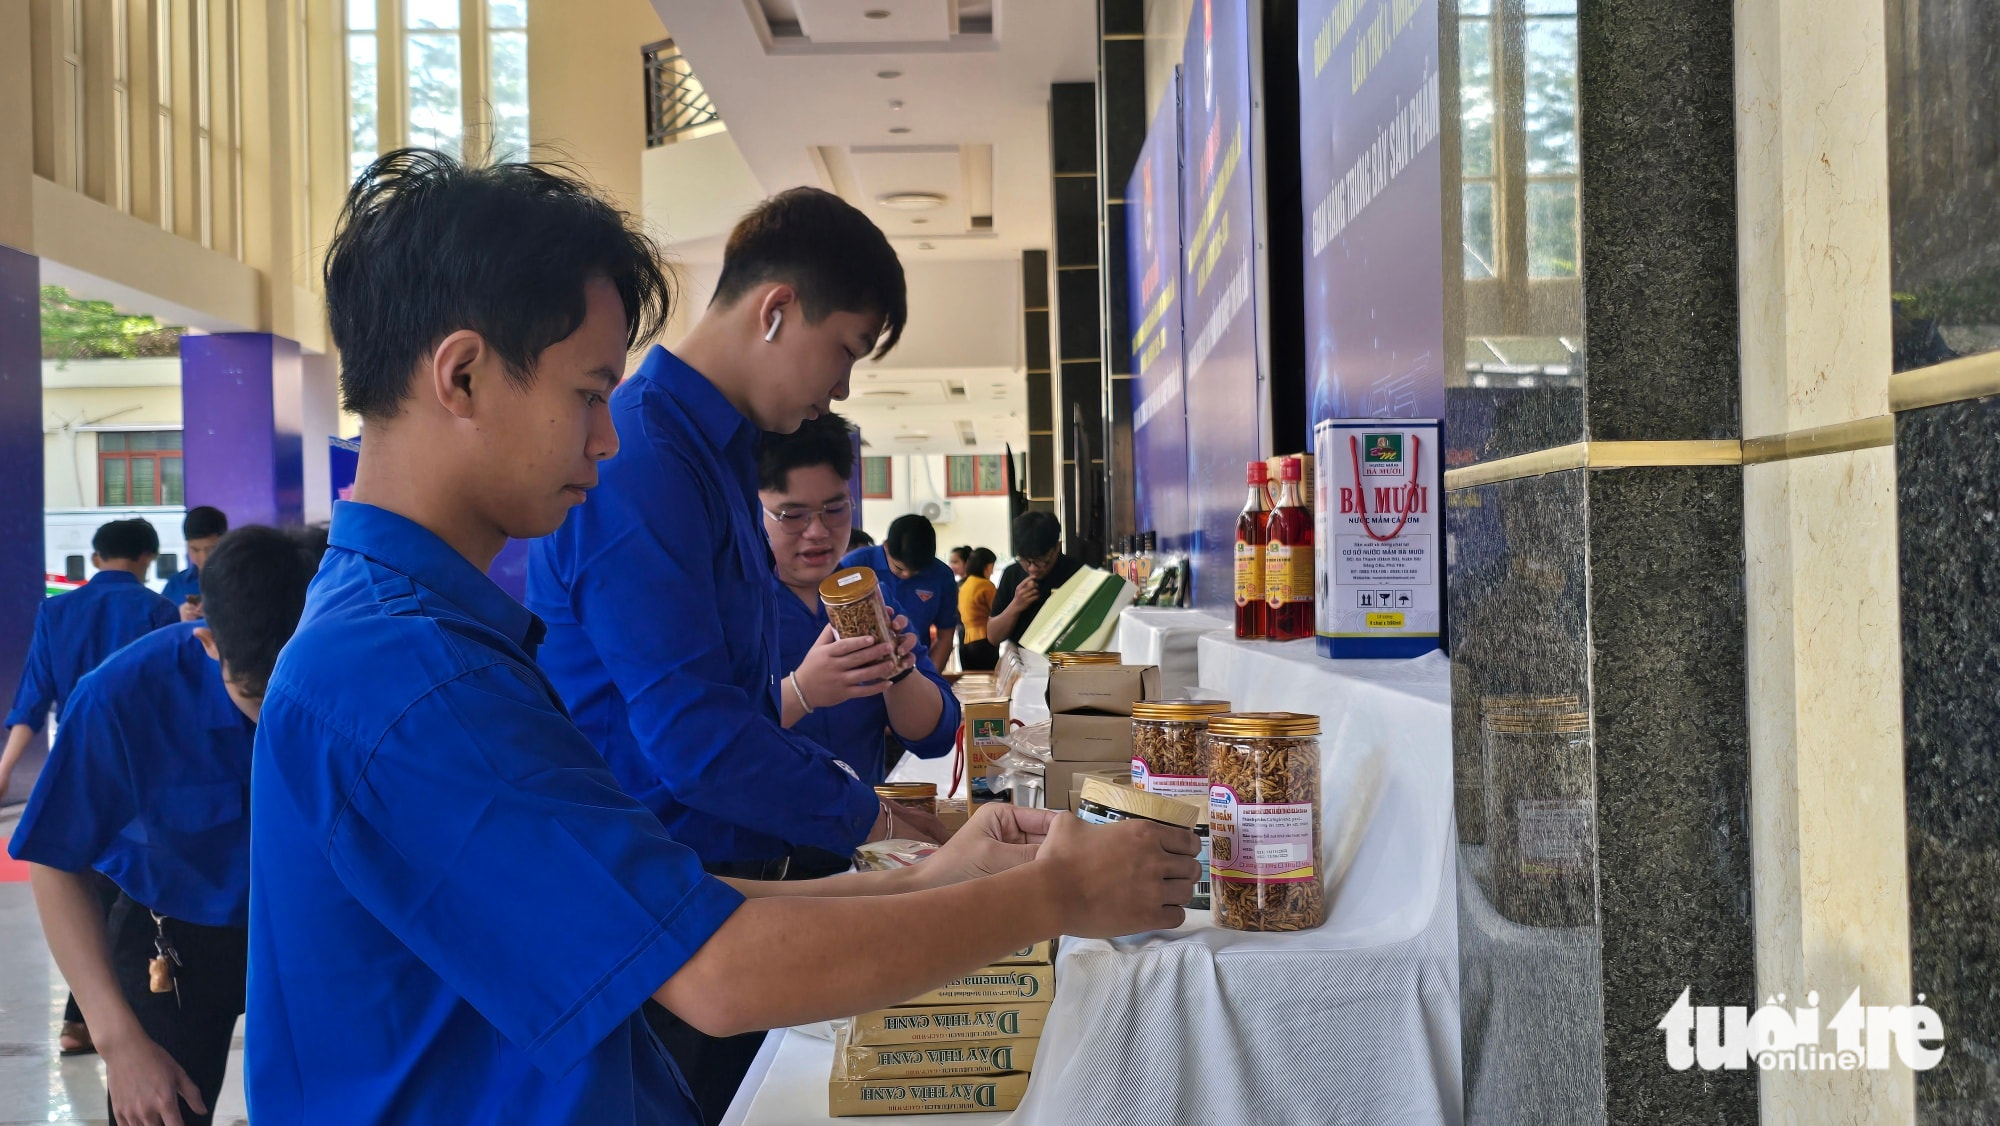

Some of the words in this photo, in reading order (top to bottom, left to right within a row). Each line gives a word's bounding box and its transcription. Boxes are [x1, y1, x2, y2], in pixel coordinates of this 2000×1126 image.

[1371, 125, 1387, 198] BÀY
[1390, 95, 1408, 179] SẢN
[1409, 56, 1439, 160] PHẨM
[964, 971, 1039, 998] Gymnema
[884, 1014, 930, 1030] CANH
[932, 1012, 972, 1030] THÌA
[974, 1010, 1020, 1034] DÂY
[878, 1051, 923, 1066] CANH
[926, 1049, 965, 1066] THÌA
[967, 1046, 1013, 1071] DÂY
[861, 1087, 906, 1101] CANH
[908, 1085, 948, 1102] THÌA
[951, 1082, 997, 1107] DÂY
